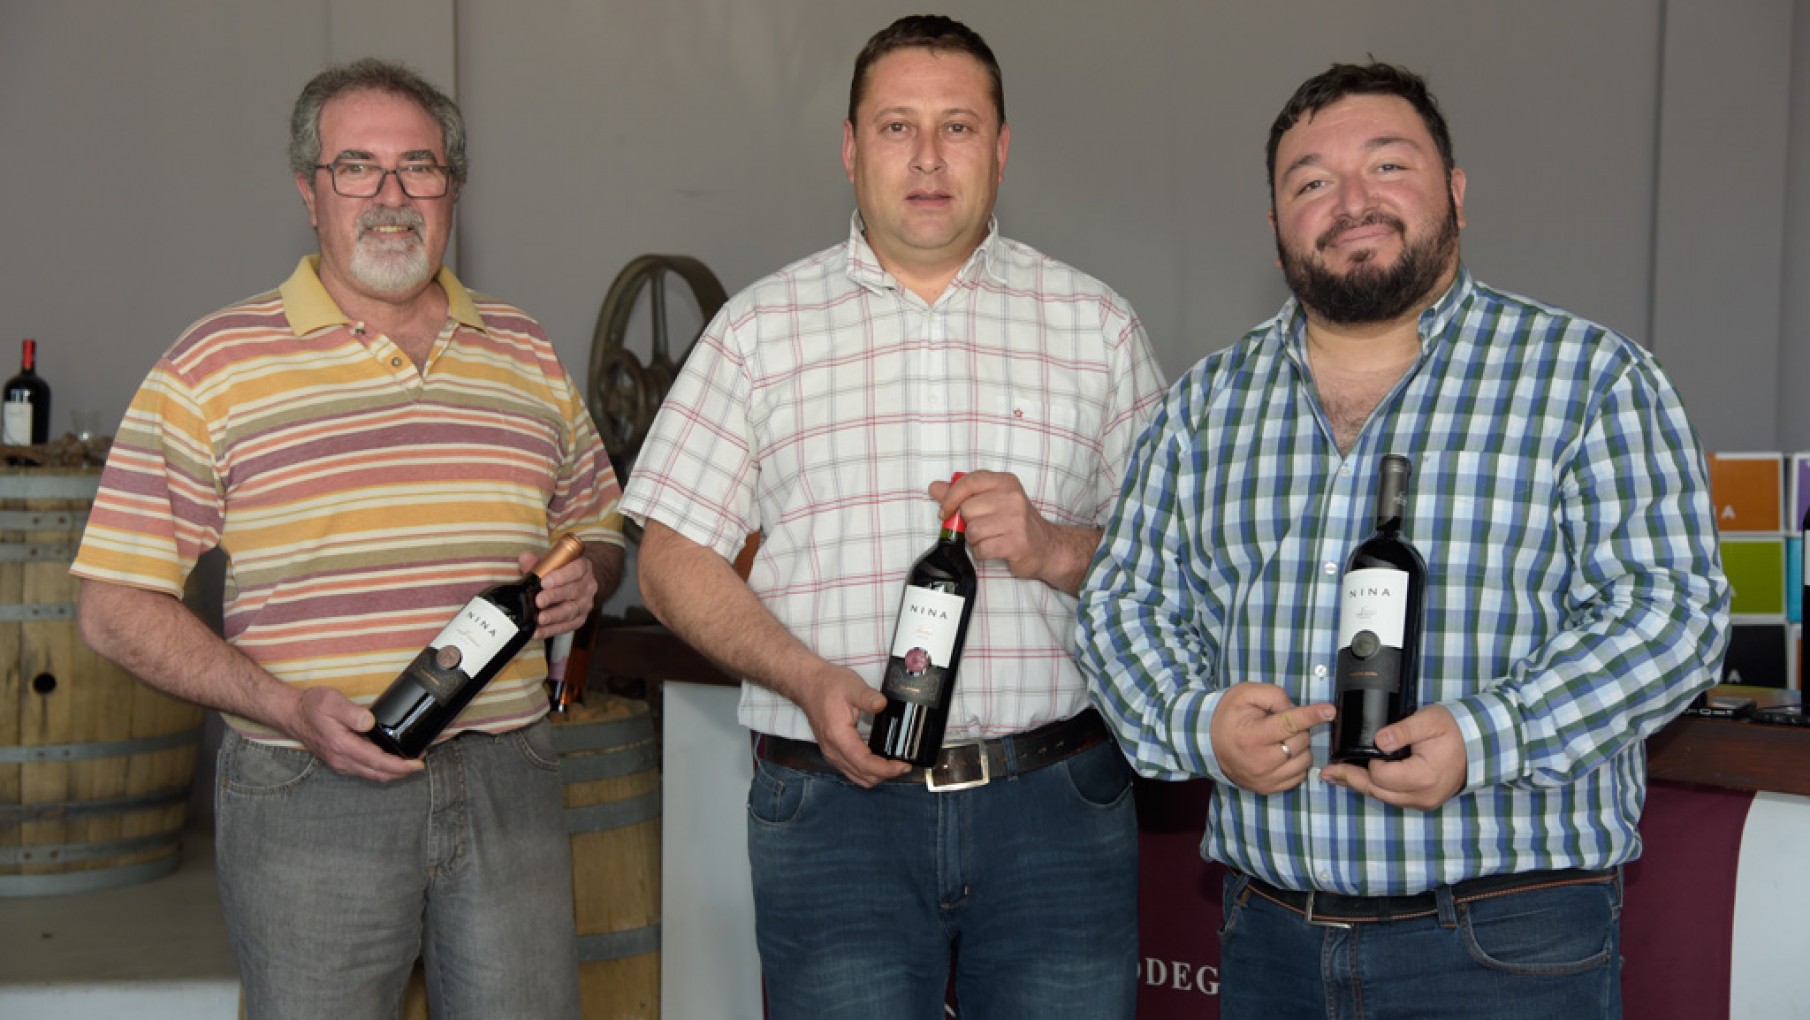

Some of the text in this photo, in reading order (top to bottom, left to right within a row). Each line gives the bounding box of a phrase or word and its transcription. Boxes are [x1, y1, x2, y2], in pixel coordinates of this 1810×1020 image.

[1349, 587, 1391, 598] NINA
[909, 604, 948, 620] NINA
[466, 611, 497, 637] NINA
[1136, 957, 1221, 996] DEG
